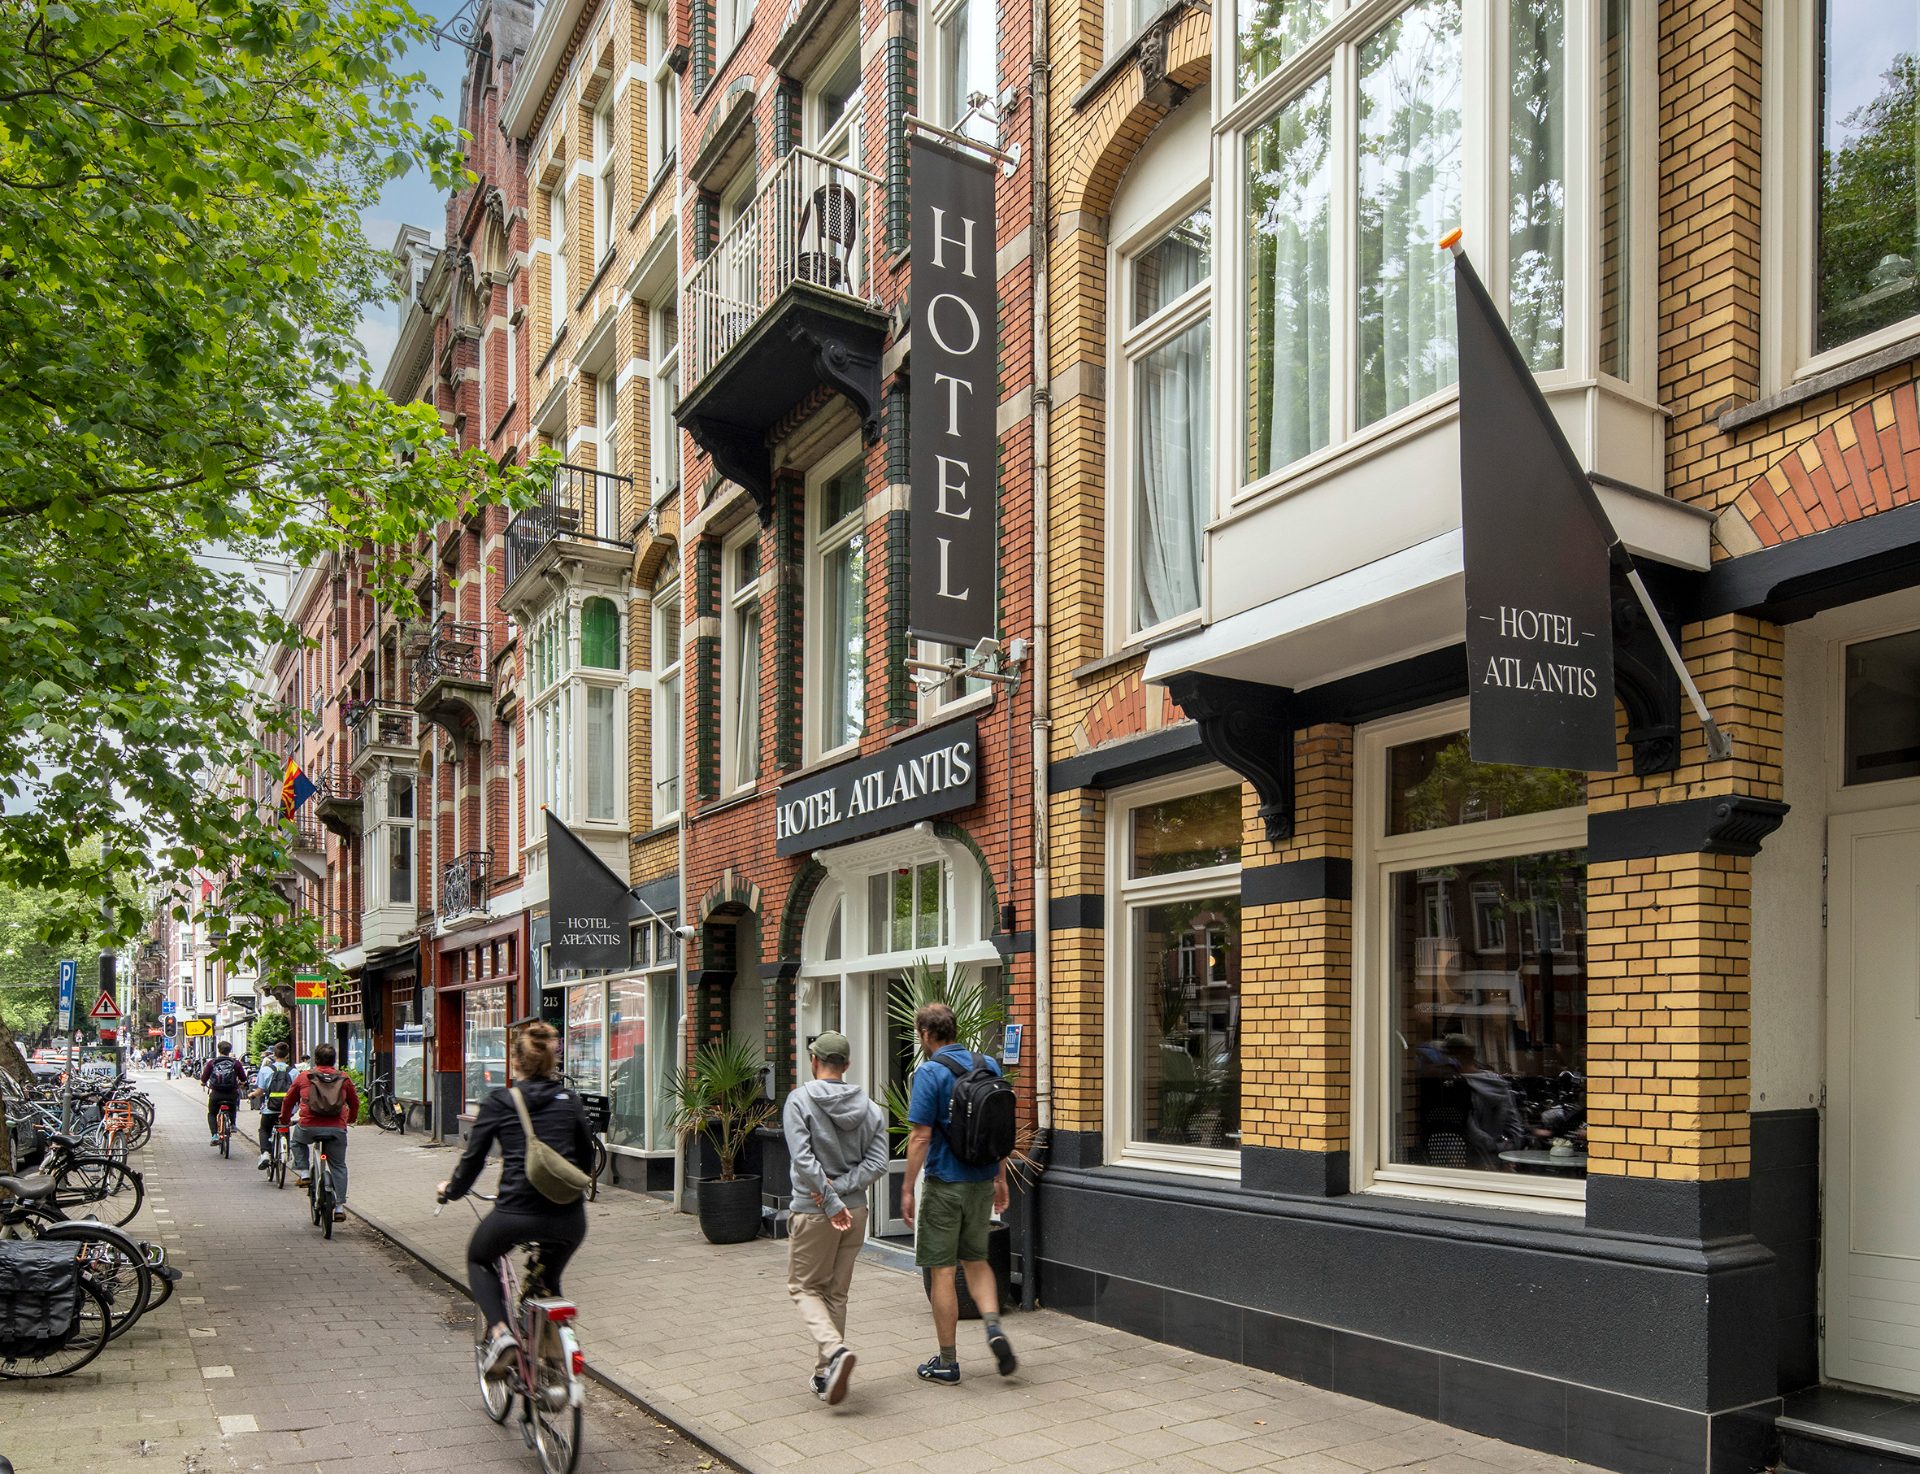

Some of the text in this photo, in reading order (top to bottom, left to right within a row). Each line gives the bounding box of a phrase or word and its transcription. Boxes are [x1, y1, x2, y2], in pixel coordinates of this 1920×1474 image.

[926, 205, 981, 602] HOTEL
[1499, 605, 1579, 647] HOTEL
[1483, 655, 1598, 698] ATLANTIS
[776, 742, 972, 841] HOTEL ATLANTIS
[559, 933, 621, 945] ATLANTIS
[568, 917, 611, 929] HOTEL
[62, 964, 71, 990] P
[543, 996, 559, 1007] 213
